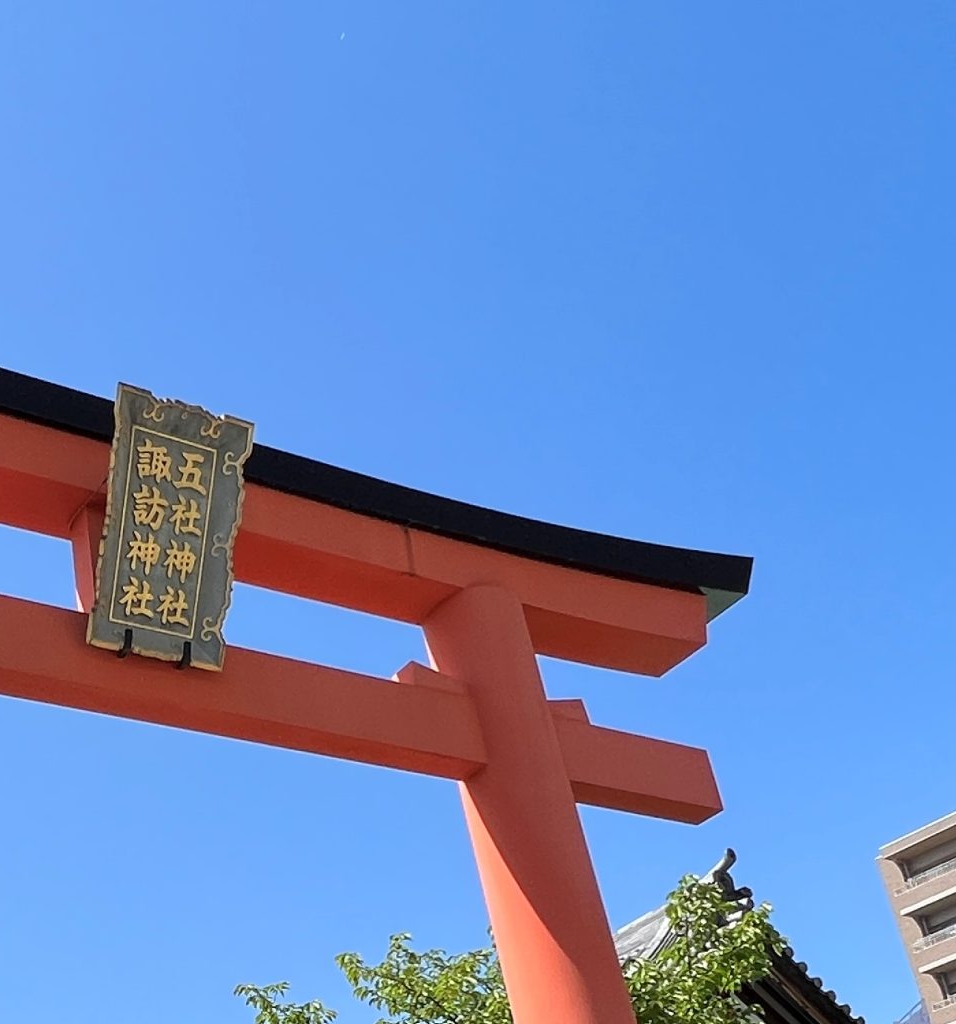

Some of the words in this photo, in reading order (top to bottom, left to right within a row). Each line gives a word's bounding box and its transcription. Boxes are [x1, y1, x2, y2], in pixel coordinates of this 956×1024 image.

[119, 440, 171, 620] 諏訪神社
[156, 451, 206, 627] 五社神社
